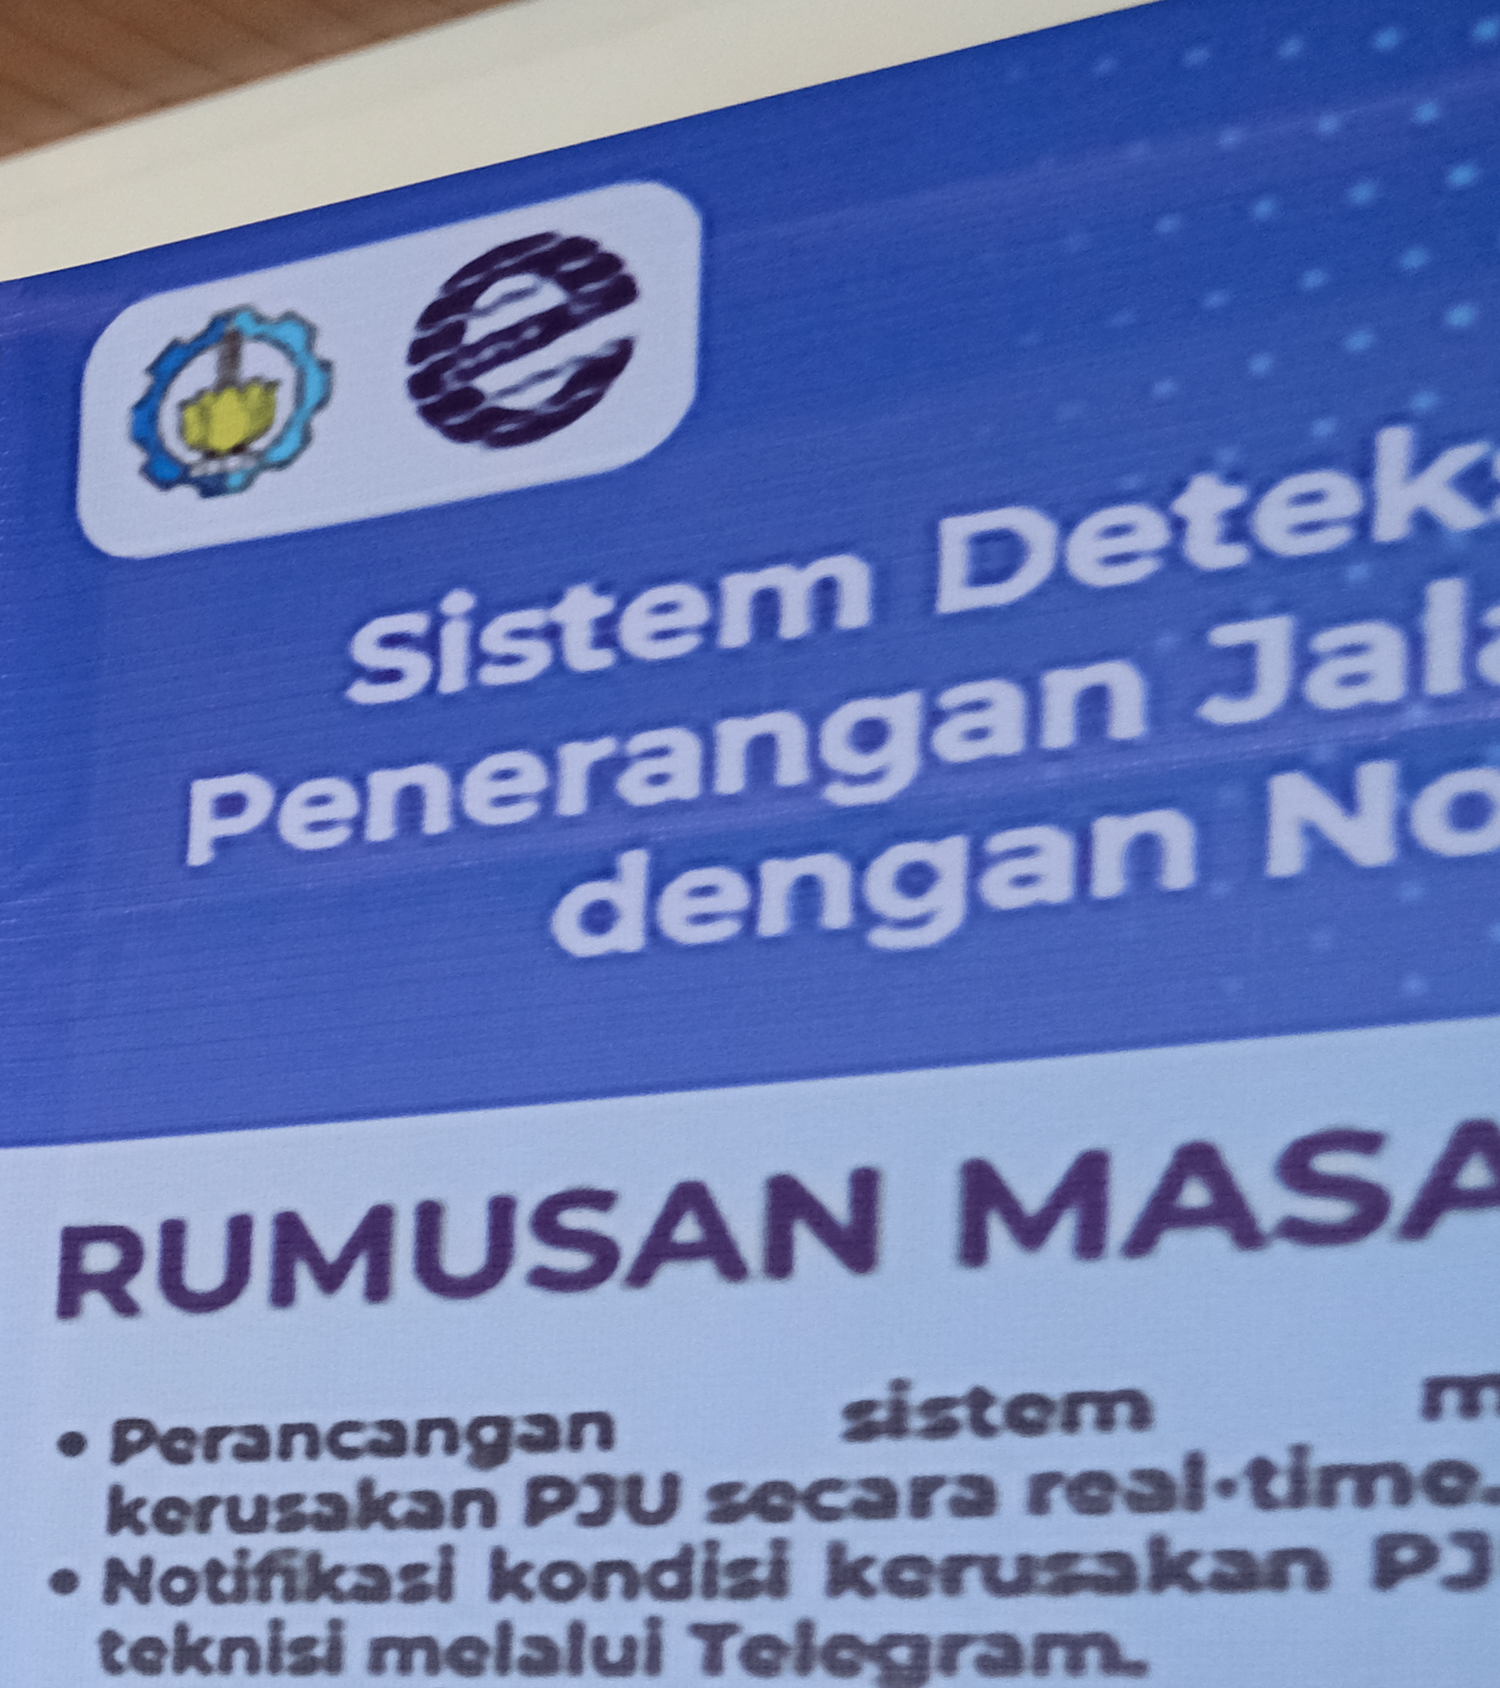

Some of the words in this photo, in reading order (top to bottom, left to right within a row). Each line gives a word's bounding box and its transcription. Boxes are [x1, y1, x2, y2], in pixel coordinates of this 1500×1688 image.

[343, 551, 873, 705] Sistem
[934, 423, 1500, 615] Detek
[184, 657, 1149, 868] Penerangan
[1198, 575, 1500, 725] Jal
[550, 806, 1197, 960] dengan
[1264, 758, 1500, 878] No
[55, 1166, 881, 1321] RUMUSAN
[957, 1117, 1500, 1269] MASA
[110, 1410, 615, 1470] Perancangan
[840, 1378, 1155, 1443] sistem
[102, 1542, 455, 1606] Notifikasi
[489, 1537, 790, 1604] kondisi
[825, 1532, 1331, 1600] kerusakan
[105, 1477, 498, 1536] kerusakan
[523, 1472, 682, 1528] PJU
[704, 1474, 997, 1525] secara
[97, 1617, 346, 1678] teknisi
[367, 1615, 663, 1678] melalui
